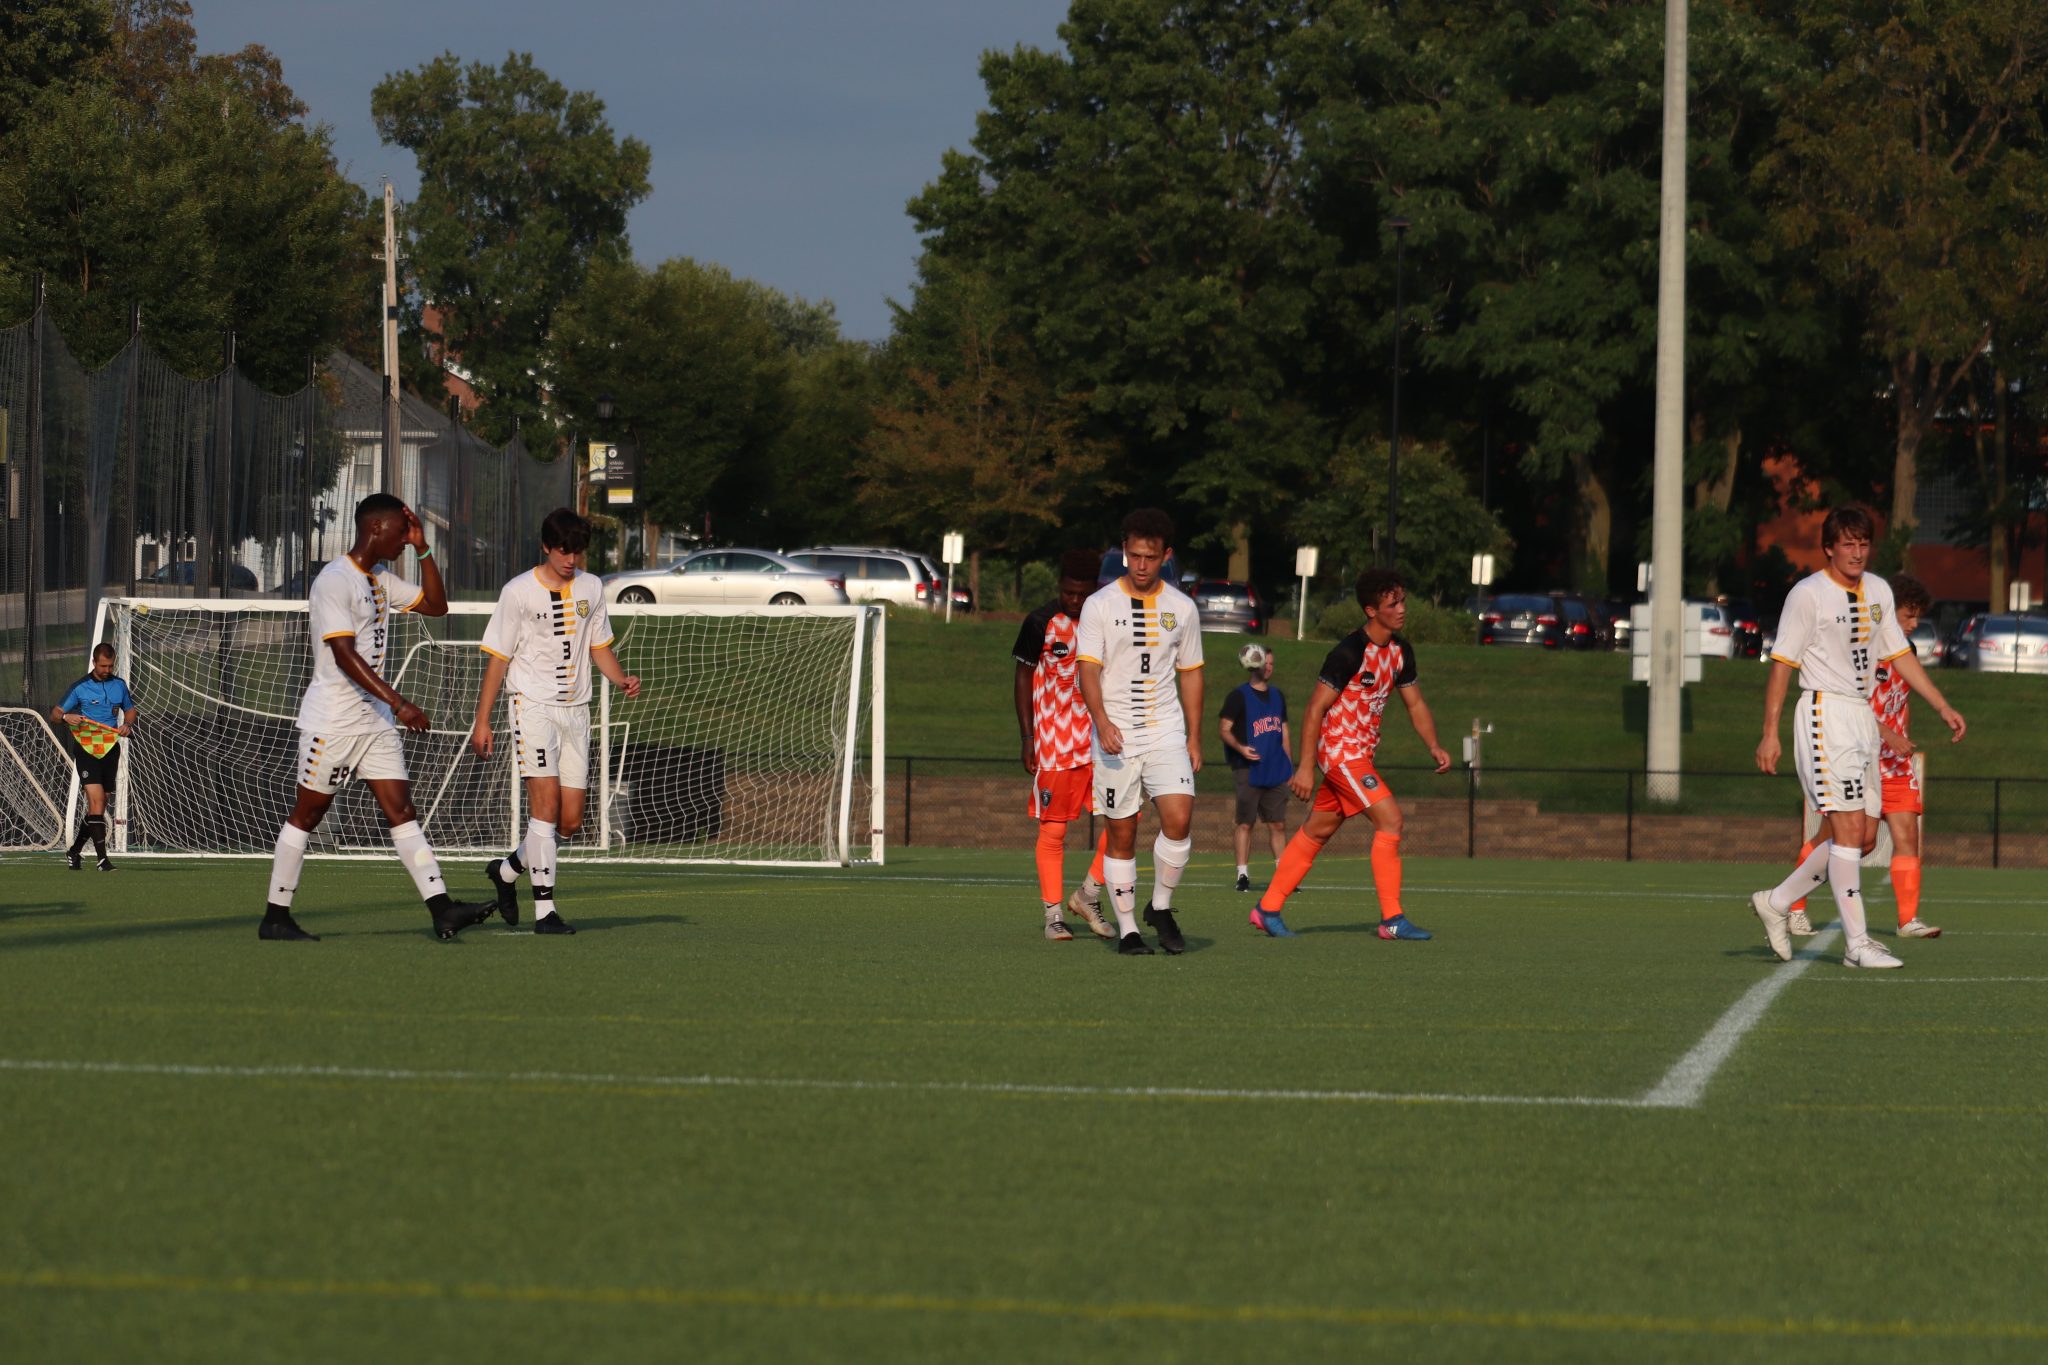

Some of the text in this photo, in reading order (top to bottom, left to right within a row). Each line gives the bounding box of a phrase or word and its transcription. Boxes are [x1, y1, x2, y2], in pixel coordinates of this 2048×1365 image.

[562, 640, 571, 660] 3
[1851, 649, 1869, 671] 22
[1140, 653, 1150, 674] 8
[536, 748, 546, 767] 3
[1106, 787, 1116, 809] 8
[1841, 778, 1864, 800] 22
